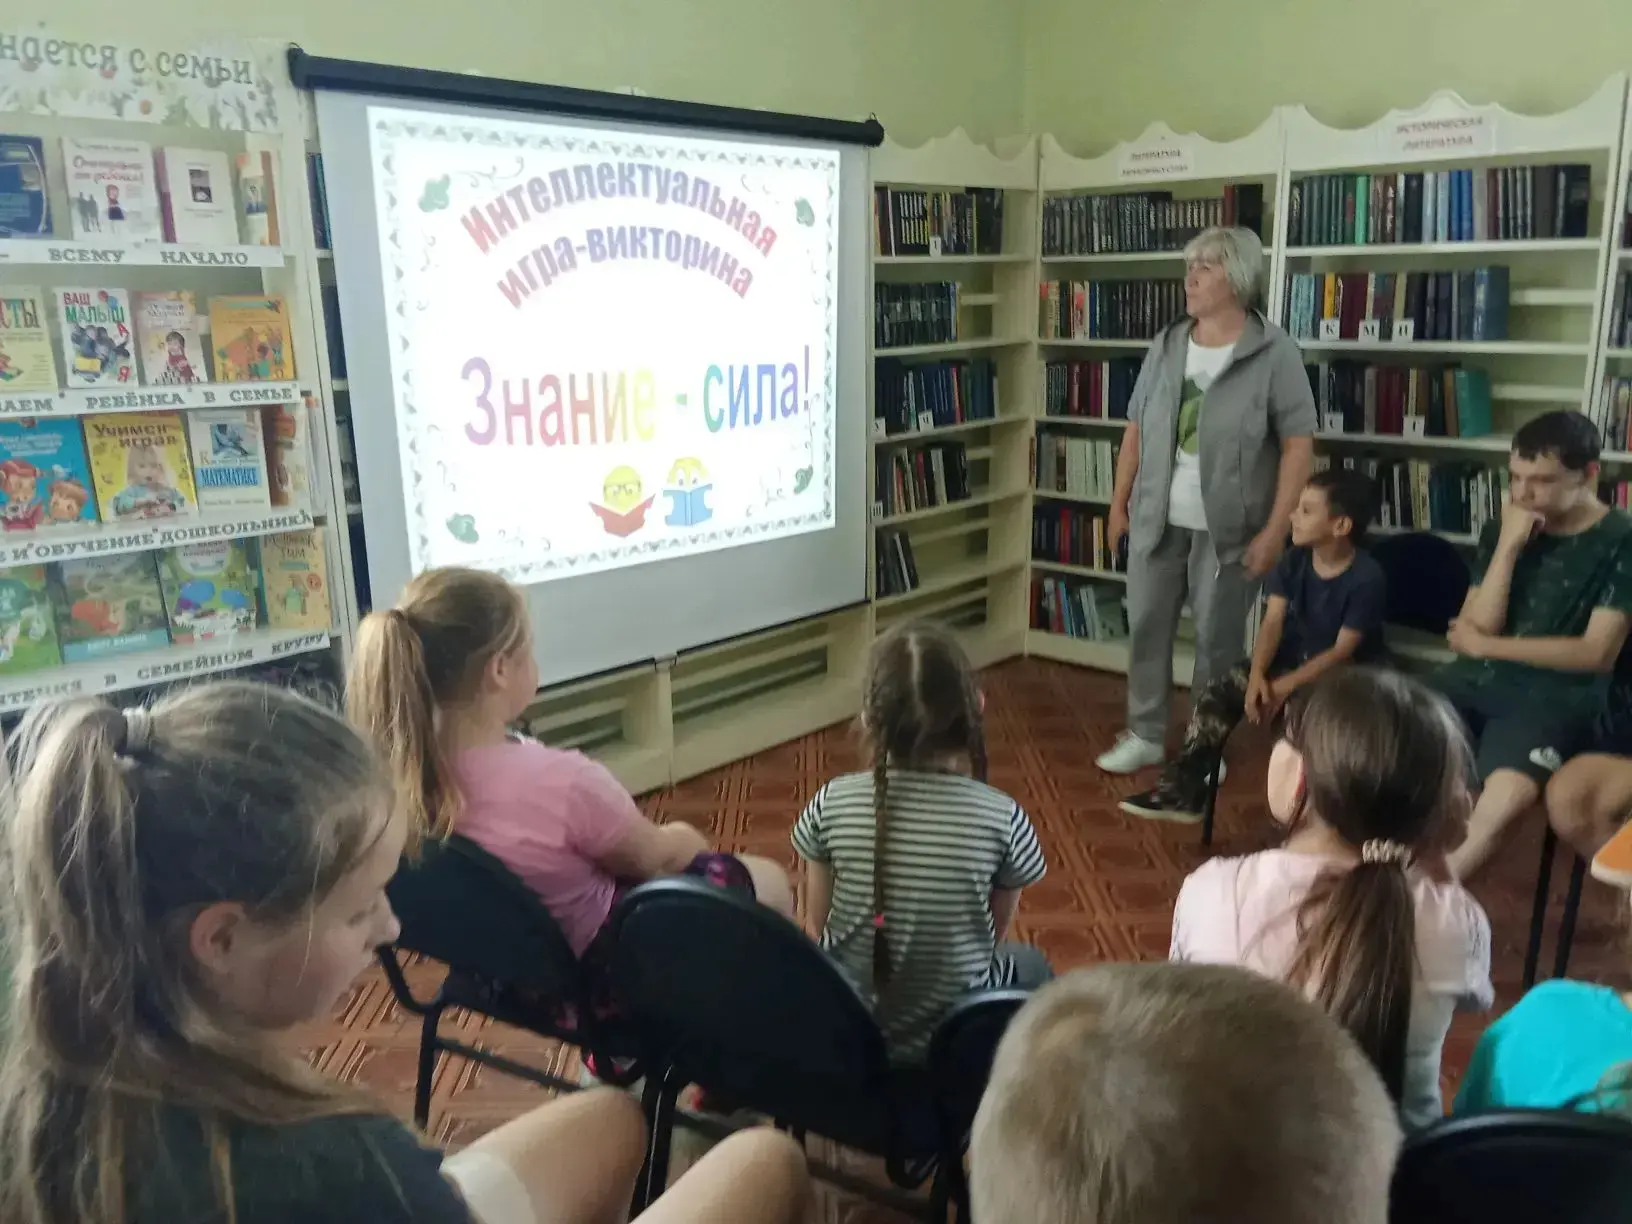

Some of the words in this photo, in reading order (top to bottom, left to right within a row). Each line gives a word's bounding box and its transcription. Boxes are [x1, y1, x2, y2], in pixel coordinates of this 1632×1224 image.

[129, 49, 146, 73] с
[156, 52, 253, 84] семьи
[460, 162, 777, 258] Интеллектуальная
[48, 248, 125, 263] ВСЕМУ
[160, 251, 248, 265] НАЧАЛО
[497, 226, 753, 309] игра-викторина
[63, 292, 91, 305] ВАШ
[65, 305, 125, 323] МАЛЫШ
[0, 398, 53, 413] АЕМ
[85, 392, 185, 410] РЕБЁНКА
[203, 391, 217, 403] В
[230, 388, 293, 402] СЕМЬЕ
[461, 356, 655, 447] Знание
[703, 345, 810, 432] сила!
[35, 533, 155, 557] ОБУЧЕНИЕ
[160, 512, 312, 545] ДОШКОЛЬНИКА
[137, 648, 253, 680] СЕМЕЙНОМ
